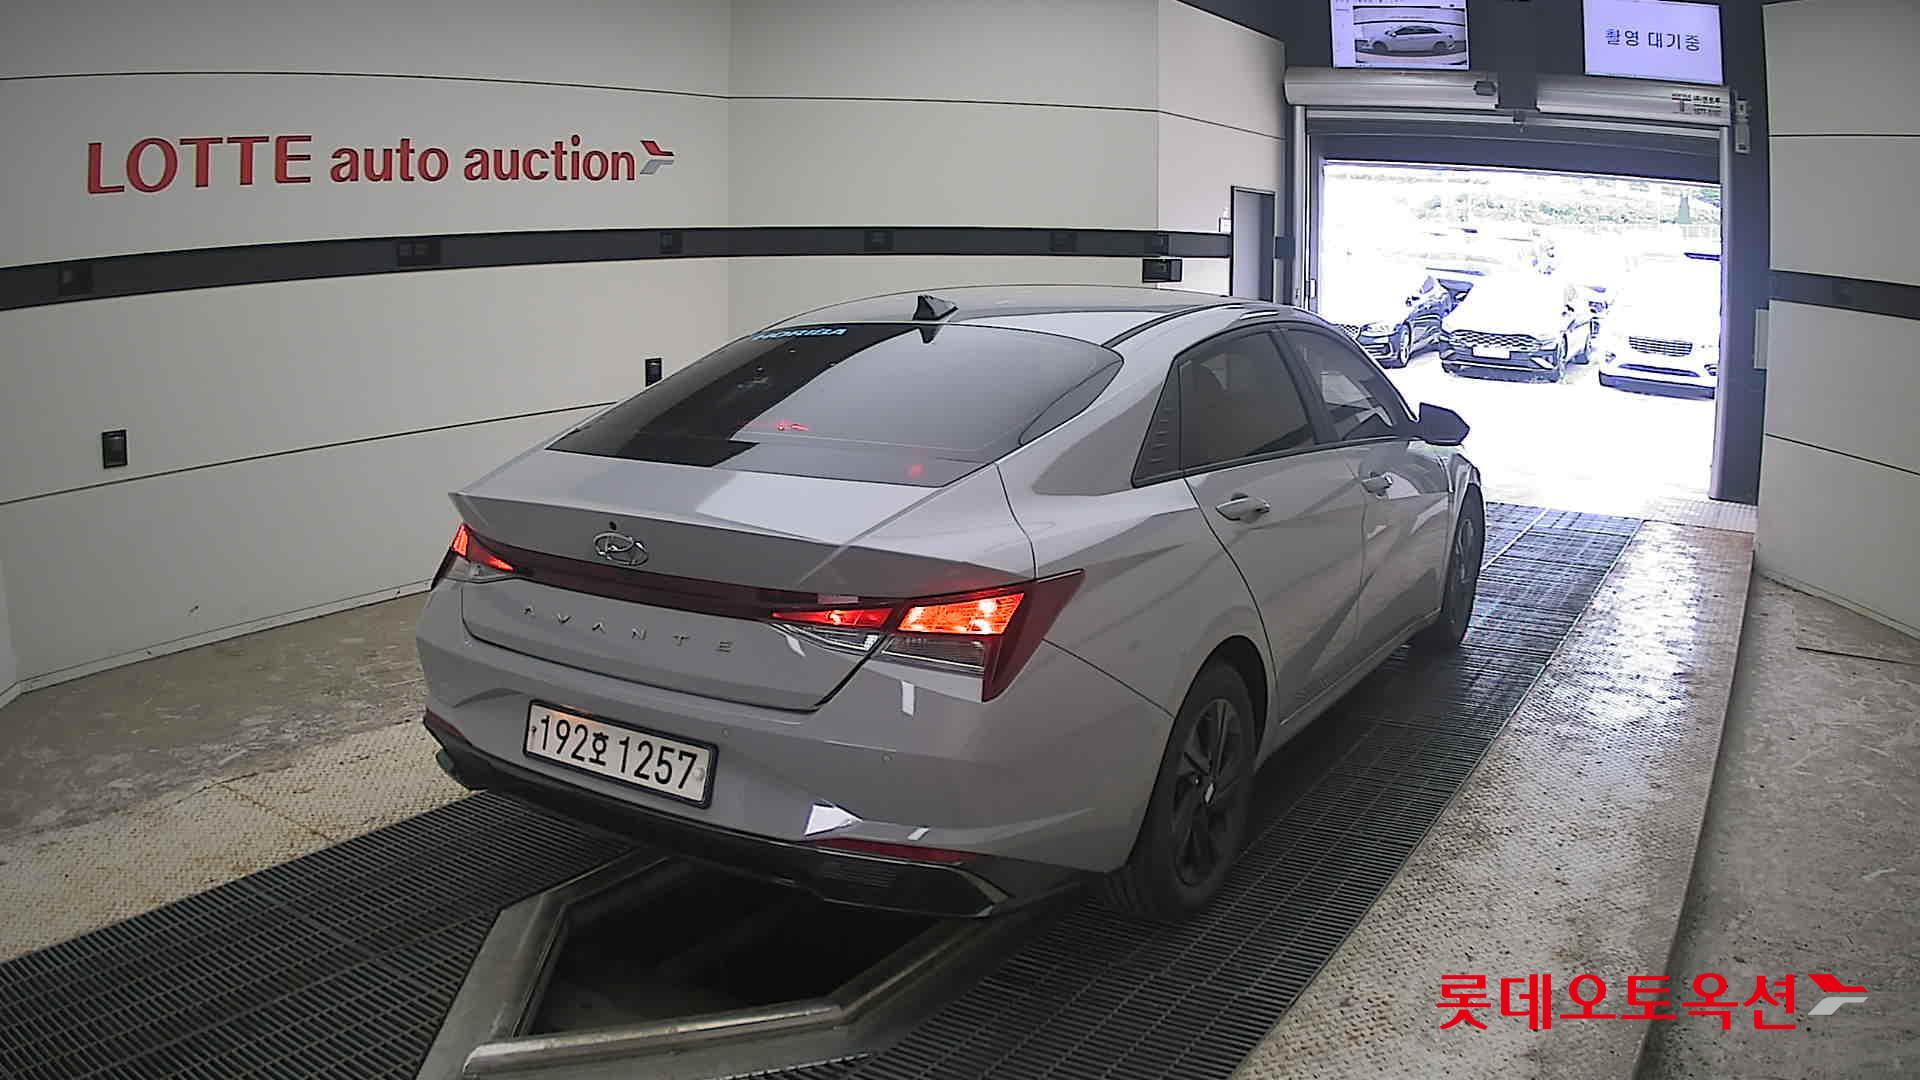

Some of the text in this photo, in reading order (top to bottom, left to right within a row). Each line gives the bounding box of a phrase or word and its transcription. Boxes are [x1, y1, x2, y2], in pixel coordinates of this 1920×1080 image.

[87, 134, 636, 194] LOTTE auto auction
[522, 604, 733, 653] AVANTE
[540, 714, 698, 790] 192호 1257
